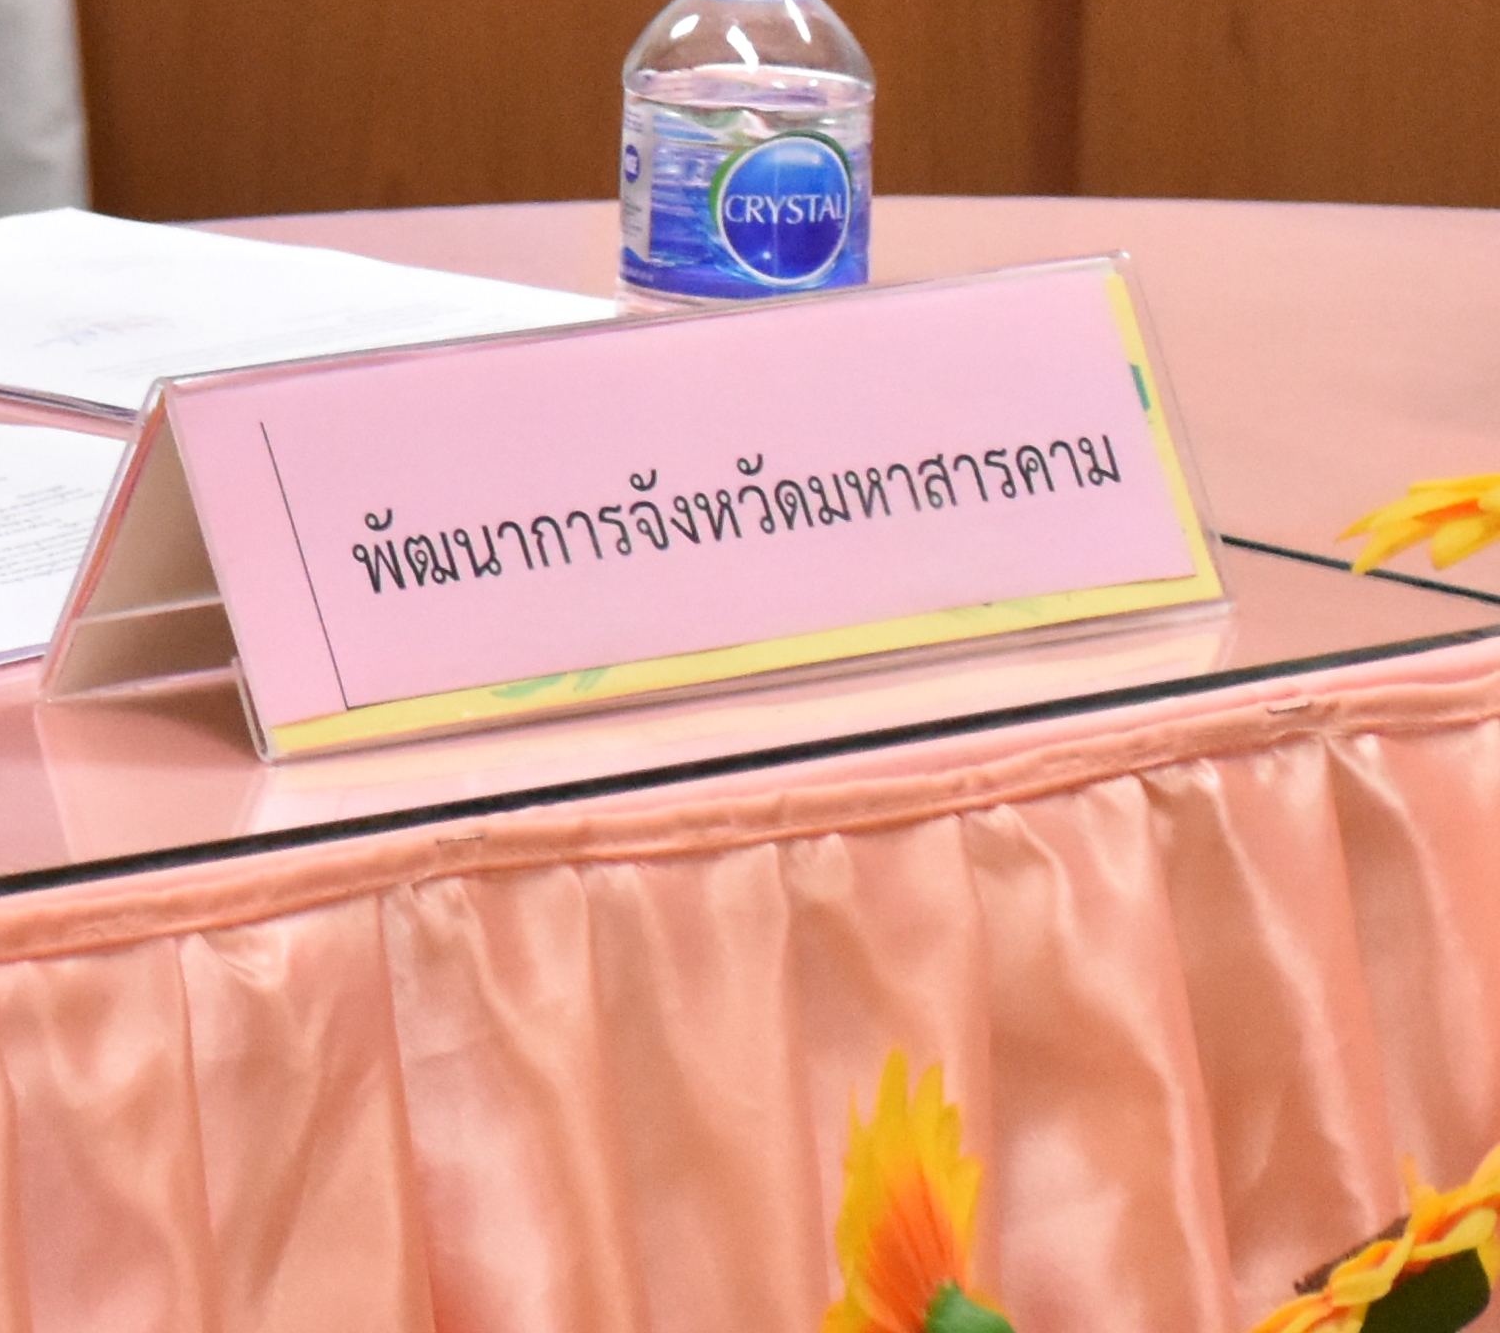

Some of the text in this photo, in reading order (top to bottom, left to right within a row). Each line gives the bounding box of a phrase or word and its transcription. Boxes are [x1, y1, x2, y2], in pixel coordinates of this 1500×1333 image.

[725, 192, 845, 225] CRYSTAL
[352, 434, 1123, 594] พัฒนาการจังหวัดมหาสารคาม
